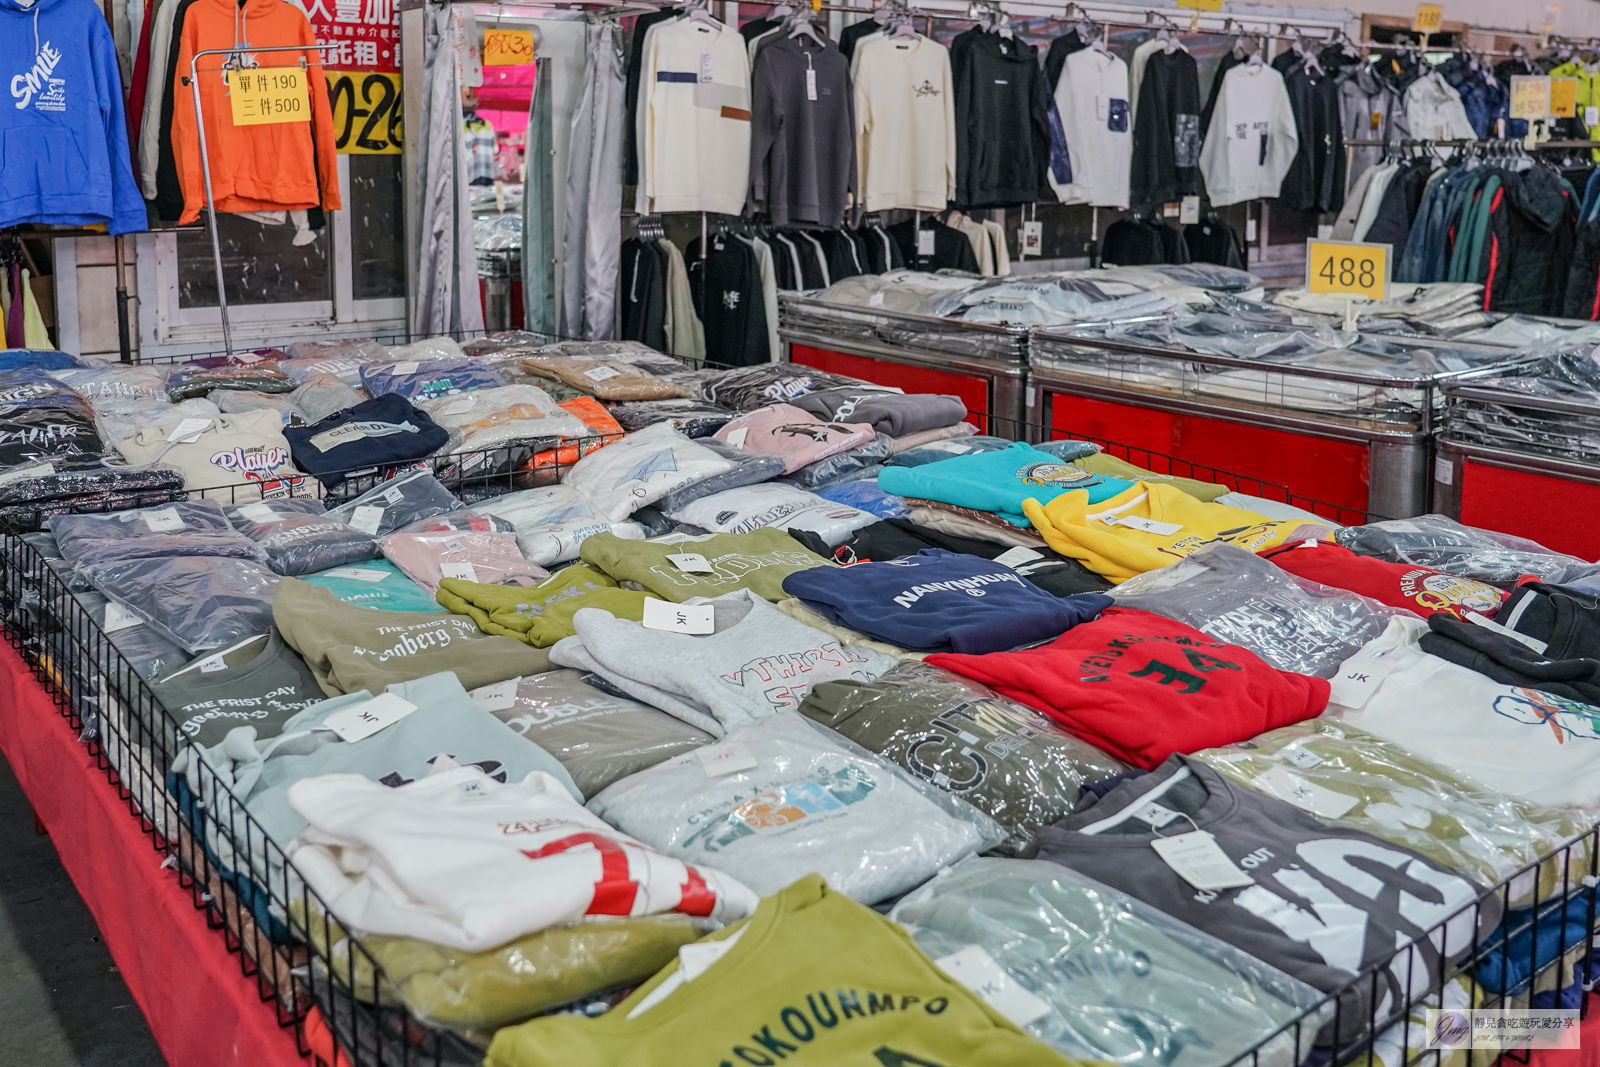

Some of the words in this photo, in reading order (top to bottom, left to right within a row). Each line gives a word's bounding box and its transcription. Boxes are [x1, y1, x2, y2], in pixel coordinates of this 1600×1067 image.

[11, 40, 62, 110] SMILE
[1319, 256, 1376, 288] 488
[210, 447, 289, 478] Player
[677, 611, 687, 626] JK
[451, 619, 476, 633] DAY
[204, 660, 216, 668] JK
[1347, 672, 1370, 683] JK
[182, 700, 216, 712] THE
[218, 697, 262, 707] FRIST
[264, 686, 296, 699] DAY
[358, 711, 379, 723] JK
[1295, 752, 1308, 761] JK
[465, 783, 479, 791] JK
[1146, 807, 1160, 818] JK
[1240, 847, 1275, 869] OUT
